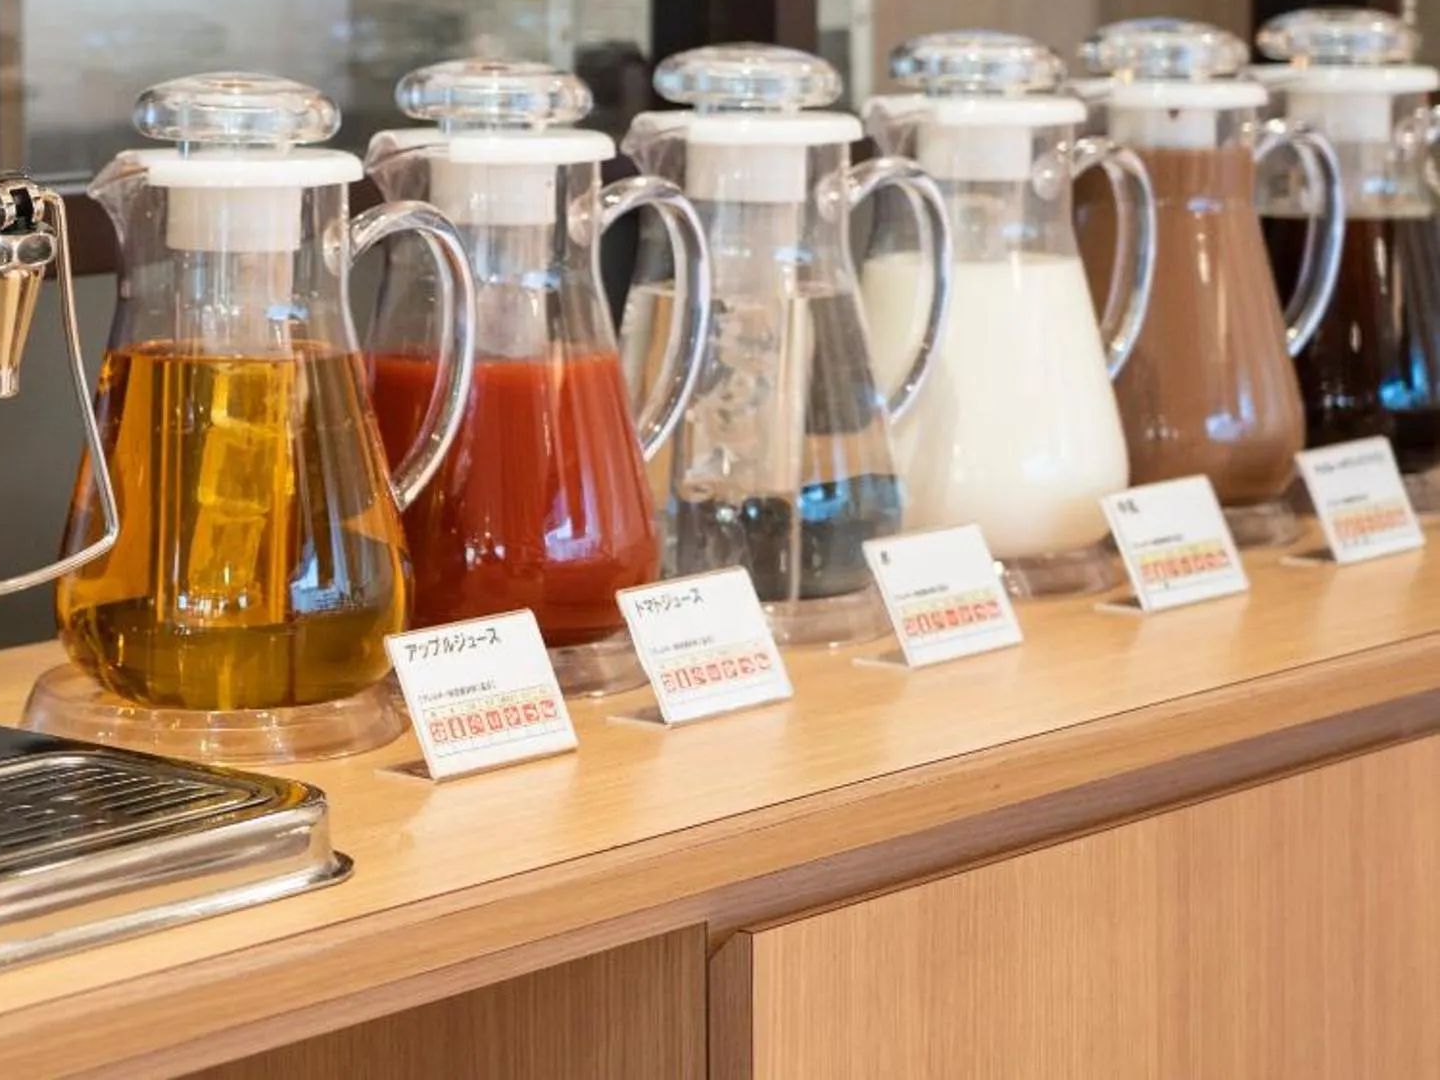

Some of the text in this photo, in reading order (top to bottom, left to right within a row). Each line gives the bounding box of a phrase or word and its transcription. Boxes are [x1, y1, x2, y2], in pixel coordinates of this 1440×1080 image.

[404, 627, 502, 662] アップルジュース
